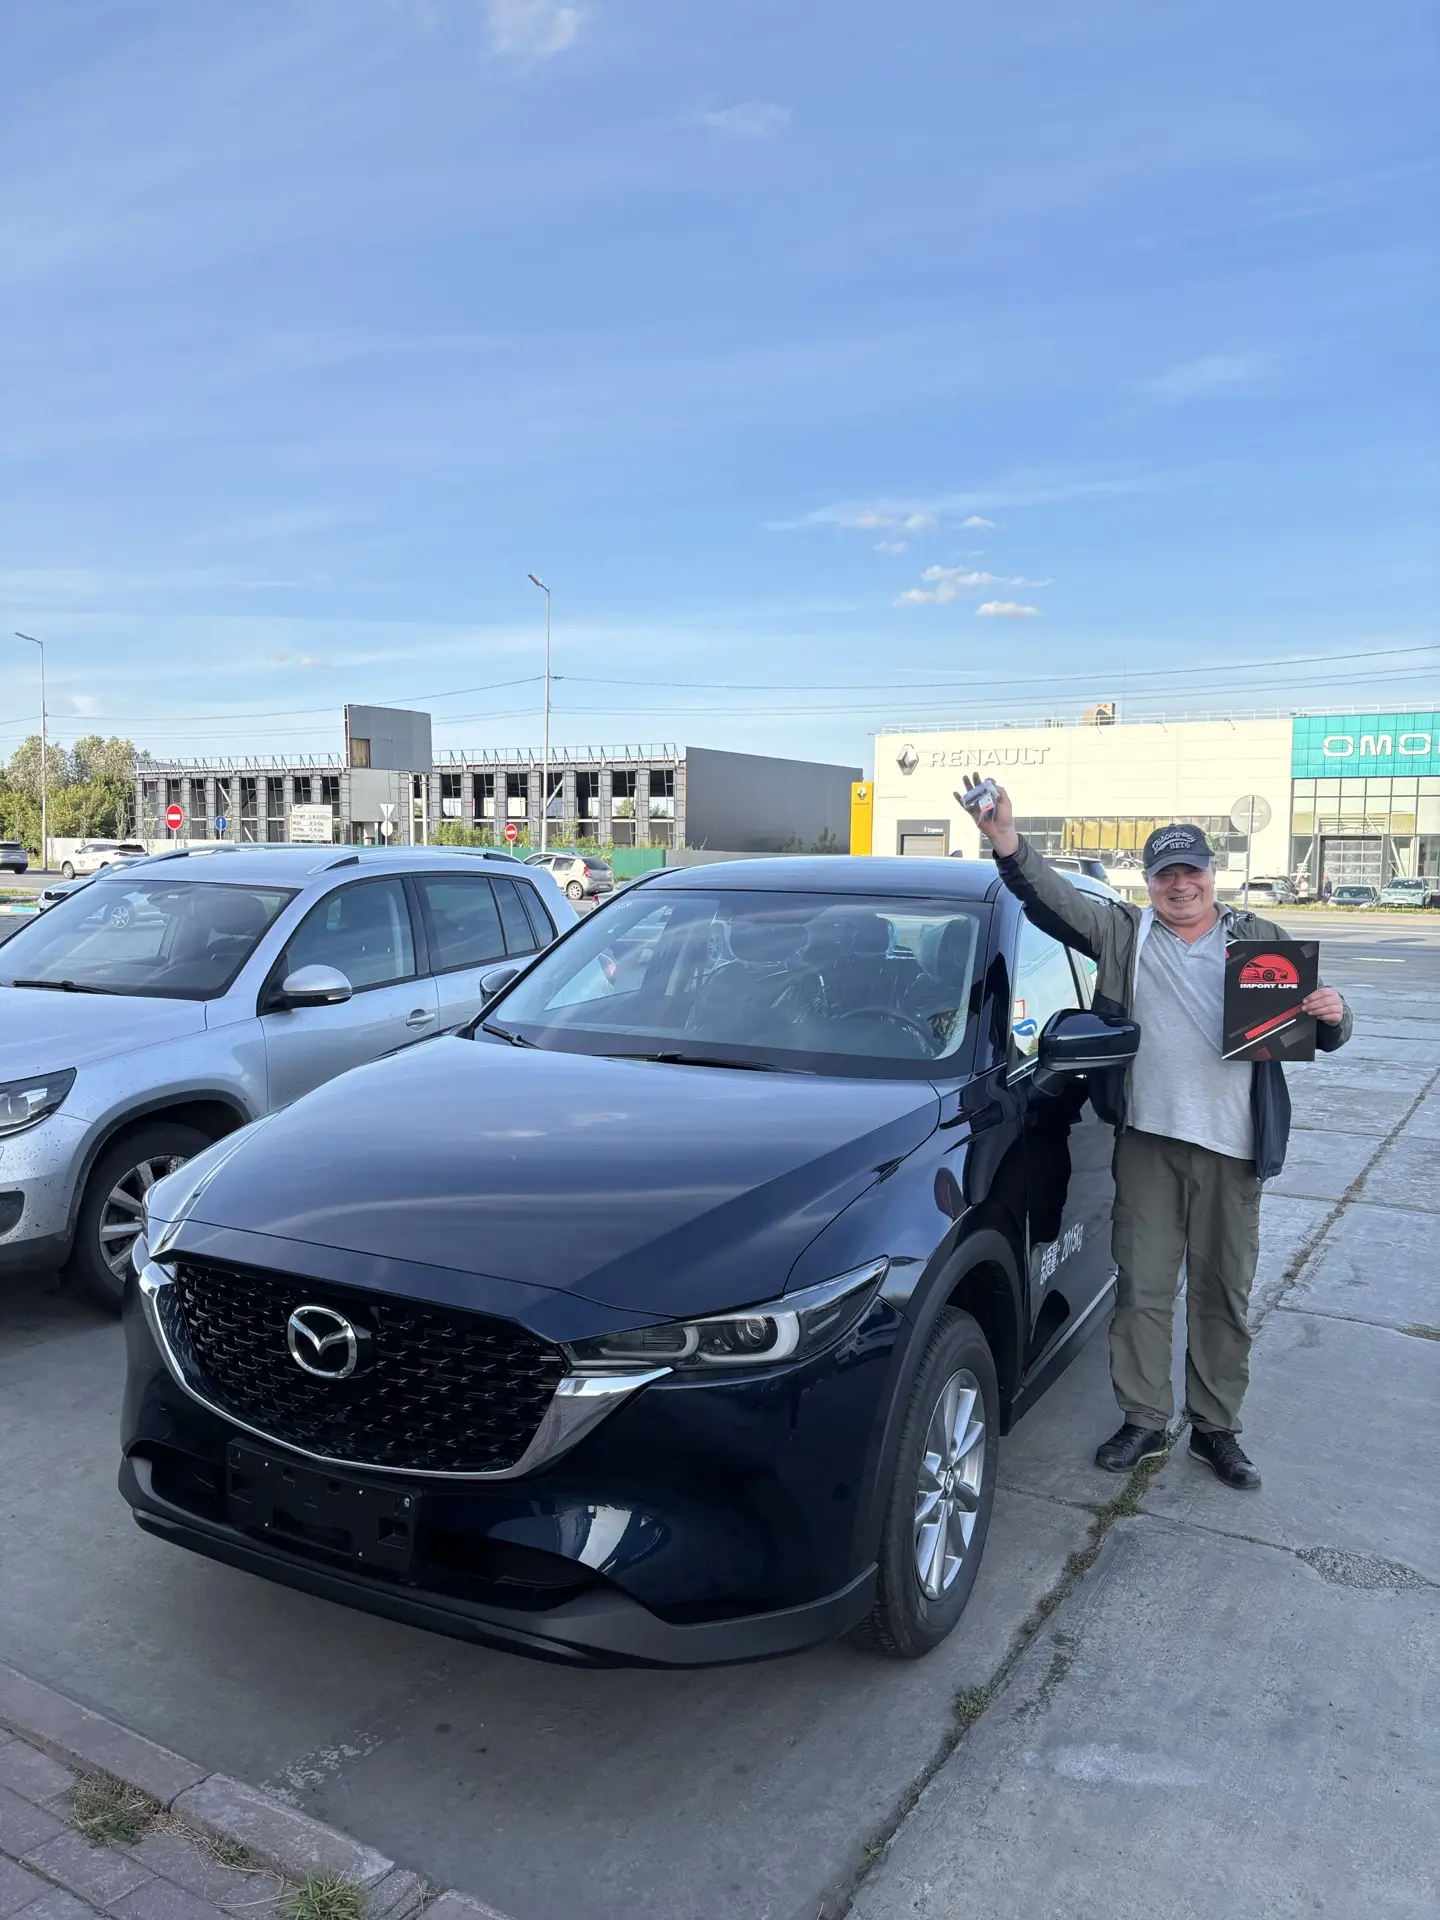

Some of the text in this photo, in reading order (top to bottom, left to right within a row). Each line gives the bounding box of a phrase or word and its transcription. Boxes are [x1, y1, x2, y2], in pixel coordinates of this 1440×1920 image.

[1323, 733, 1440, 757] OMO
[929, 747, 1050, 767] RENAULT
[1152, 832, 1196, 852] Discovery
